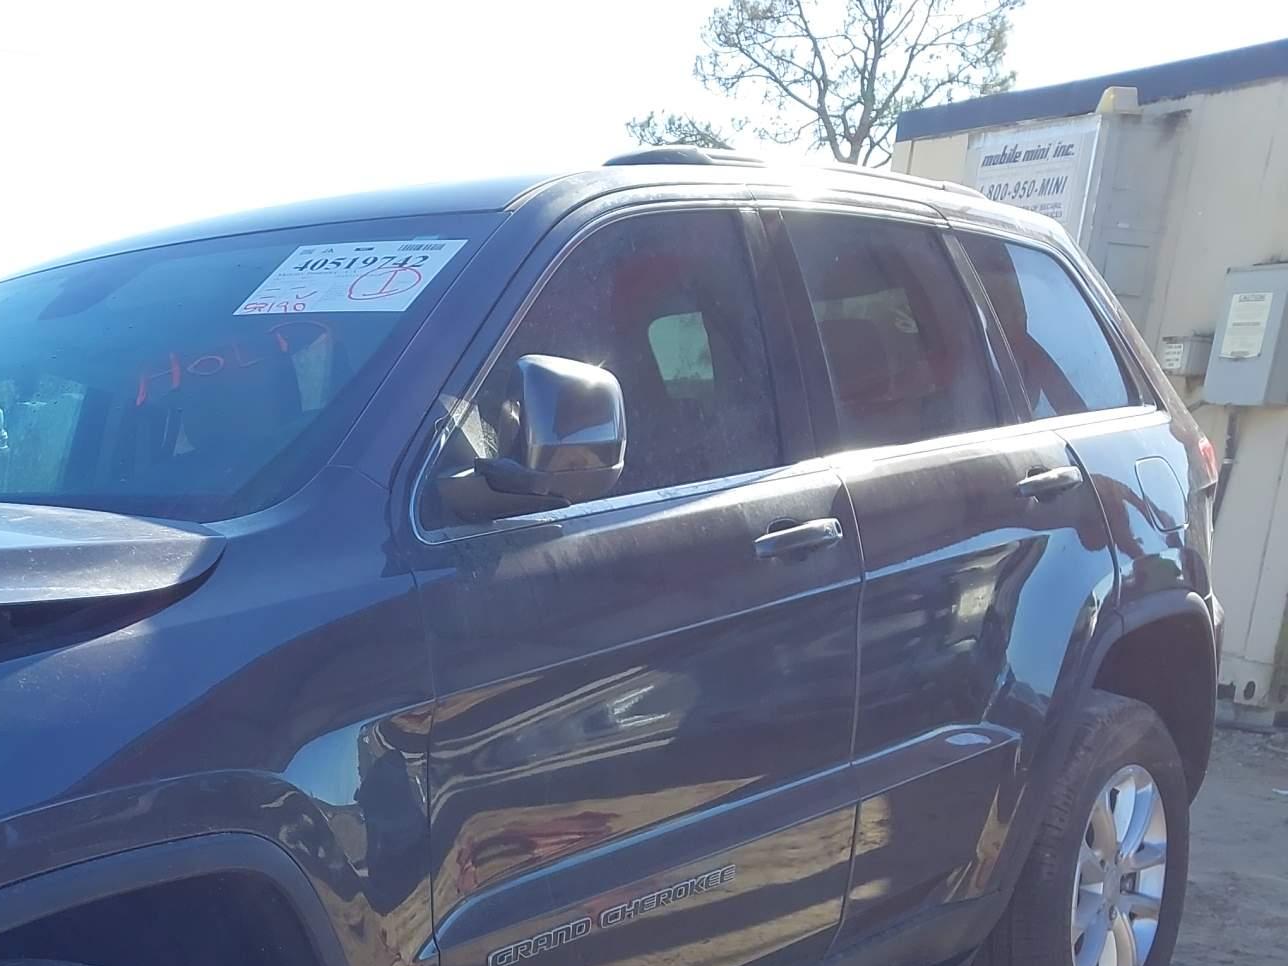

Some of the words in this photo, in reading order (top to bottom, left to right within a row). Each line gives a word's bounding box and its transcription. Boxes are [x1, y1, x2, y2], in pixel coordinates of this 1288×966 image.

[981, 144, 1022, 167] mobile
[1052, 142, 1075, 158] inc.
[979, 176, 1069, 201] 1800-950-MINI
[293, 255, 430, 272] 40519742
[598, 864, 736, 929] CHEROKEE
